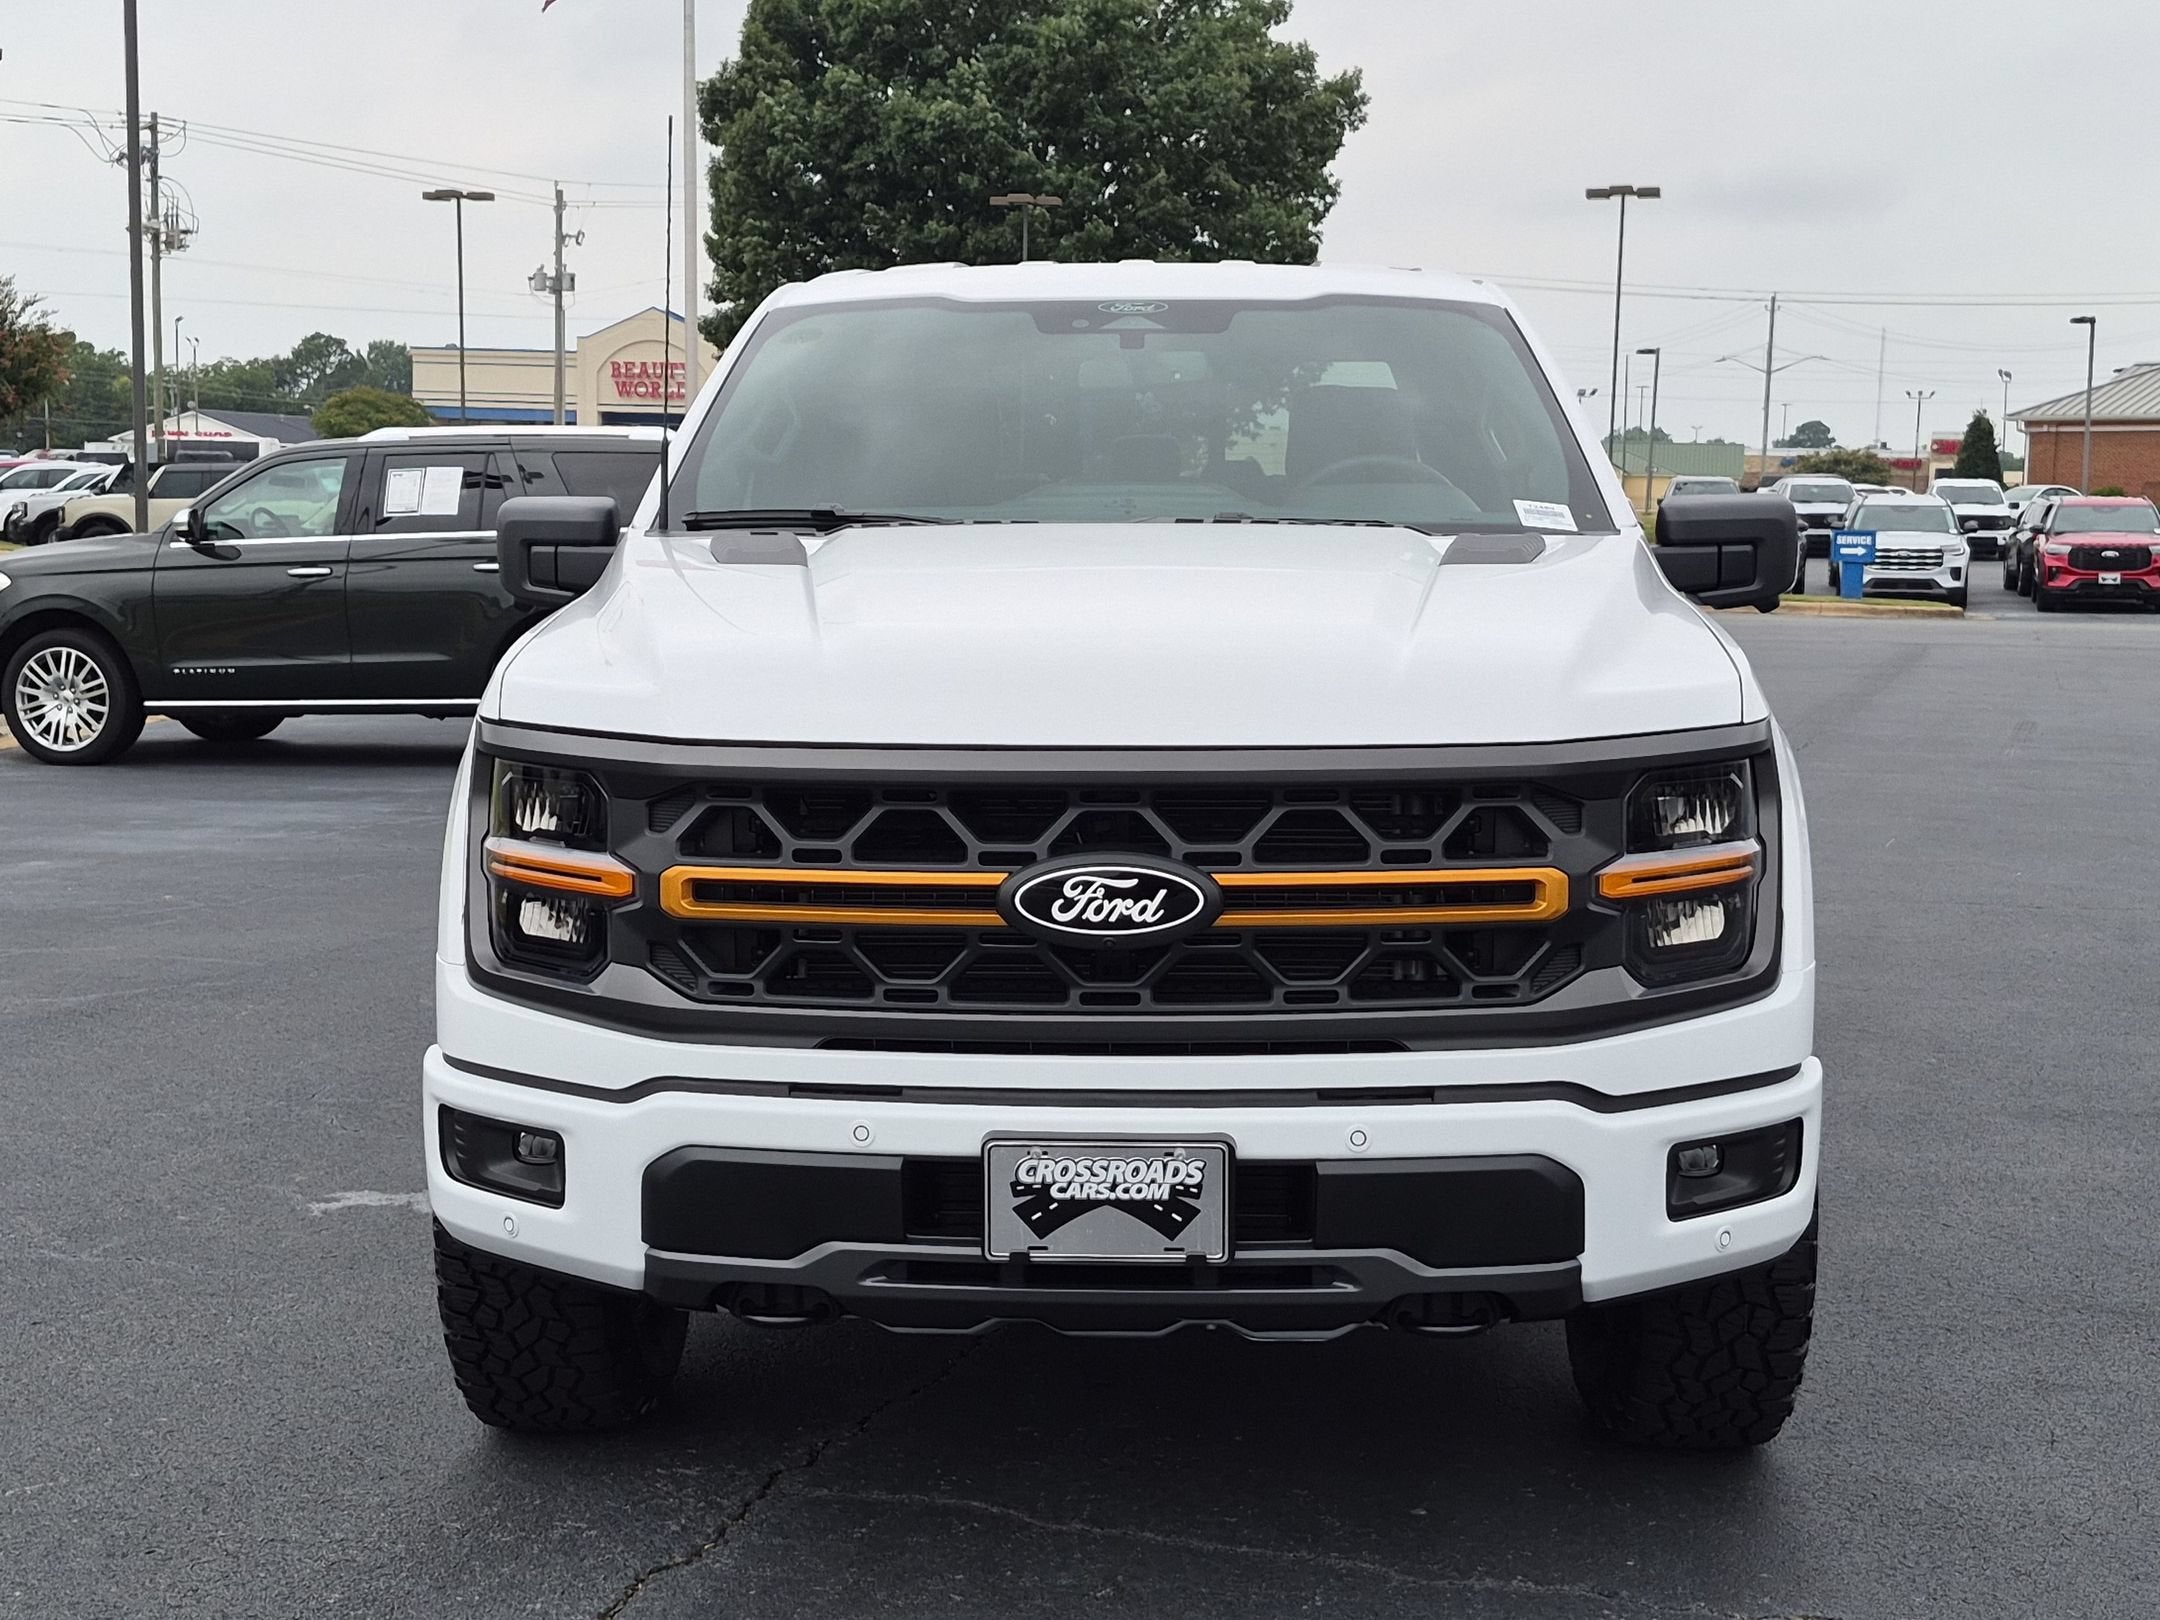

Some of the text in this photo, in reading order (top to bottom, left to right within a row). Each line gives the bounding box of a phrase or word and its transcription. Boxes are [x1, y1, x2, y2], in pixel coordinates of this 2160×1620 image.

[1110, 302, 1156, 313] Ford
[615, 380, 686, 399] WORD
[1836, 535, 1872, 545] SERVICE
[1051, 875, 1168, 923] Ford
[1016, 1157, 1207, 1185] CROSSROADS
[1049, 1183, 1172, 1200] CARS.COM
